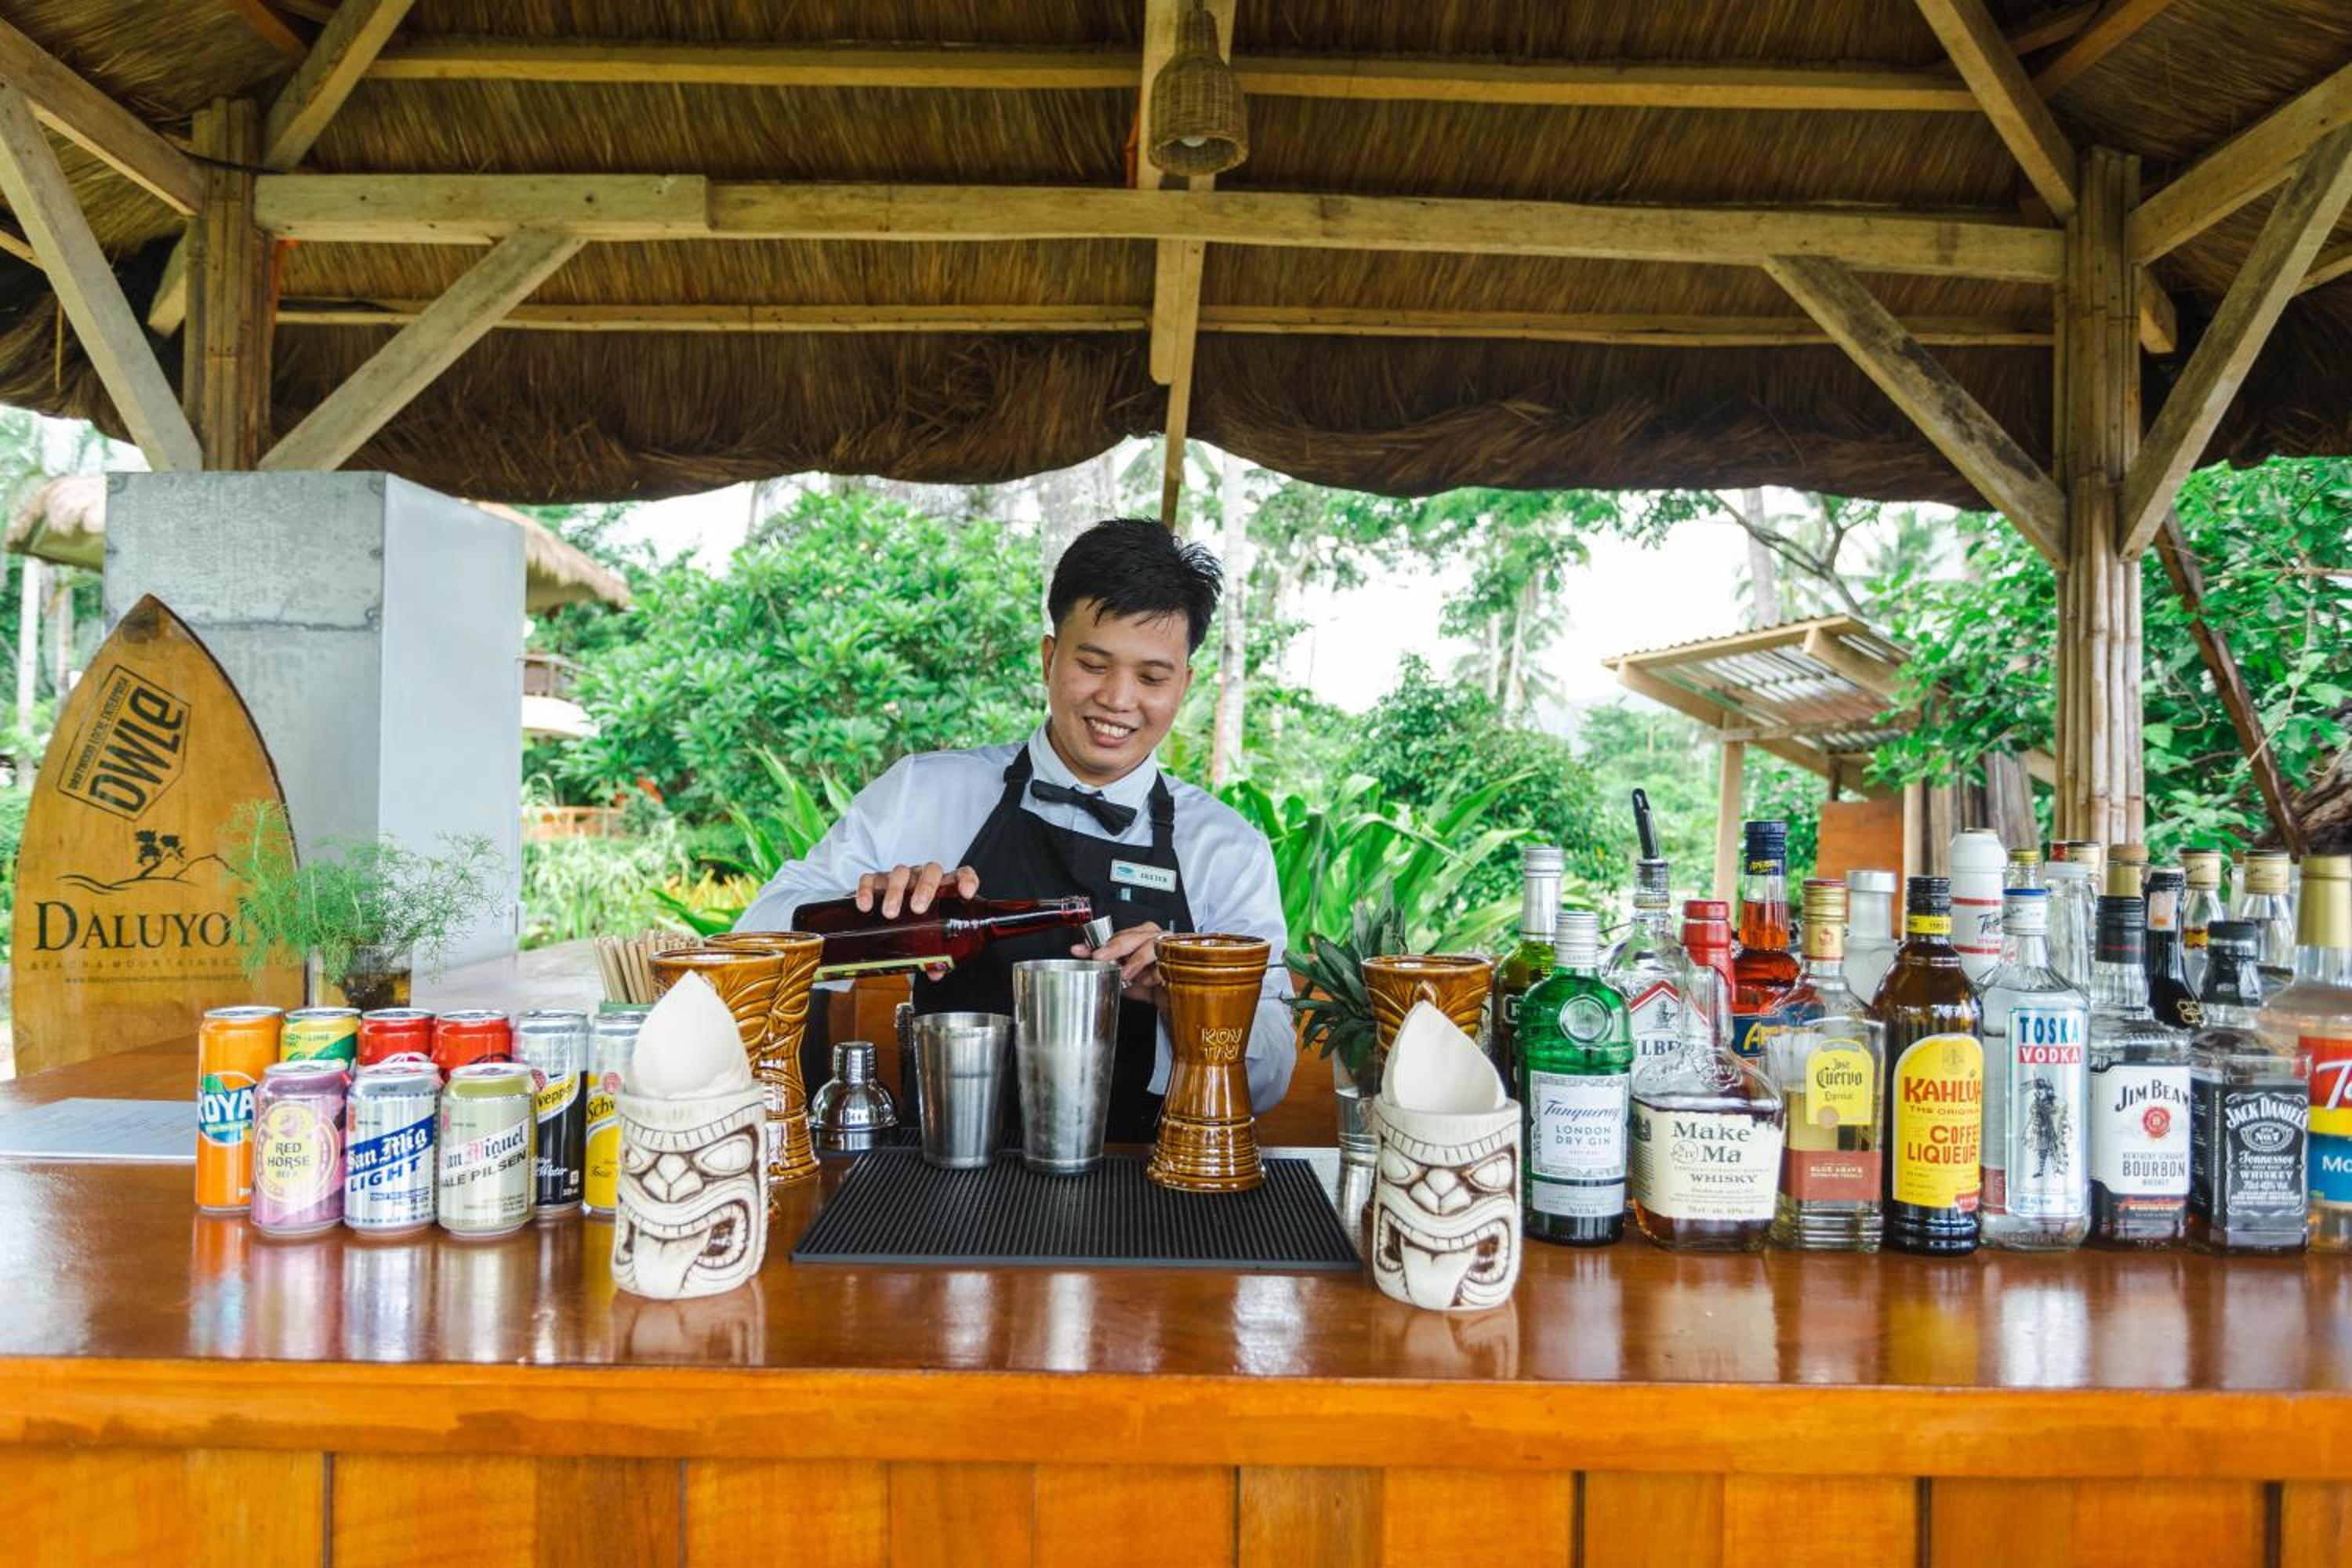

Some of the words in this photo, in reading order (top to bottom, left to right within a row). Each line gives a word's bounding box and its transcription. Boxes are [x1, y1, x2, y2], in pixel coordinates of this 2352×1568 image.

[2019, 1016, 2080, 1044] TOSKA
[2021, 1047, 2081, 1063] VODKA
[1816, 1066, 1863, 1089] Cuervo
[2114, 1085, 2147, 1112] JIM
[1543, 1099, 1621, 1122] Tanqueray
[2224, 1101, 2258, 1129] JACK
[1555, 1124, 1612, 1135] LONDON
[275, 1142, 303, 1156] RED
[379, 1127, 427, 1164] Mig
[464, 1125, 525, 1164] Miguel
[1555, 1136, 1584, 1145] DRY
[1588, 1137, 1612, 1146] GIN
[267, 1156, 311, 1170] HORSE
[470, 1149, 528, 1183] PILSEN
[2238, 1150, 2296, 1165] Tennessee
[350, 1156, 421, 1192] LIGHT
[2122, 1160, 2186, 1177] BOURBON
[2239, 1171, 2295, 1180] WHISKEY
[1690, 1174, 1758, 1184] WHISKY
